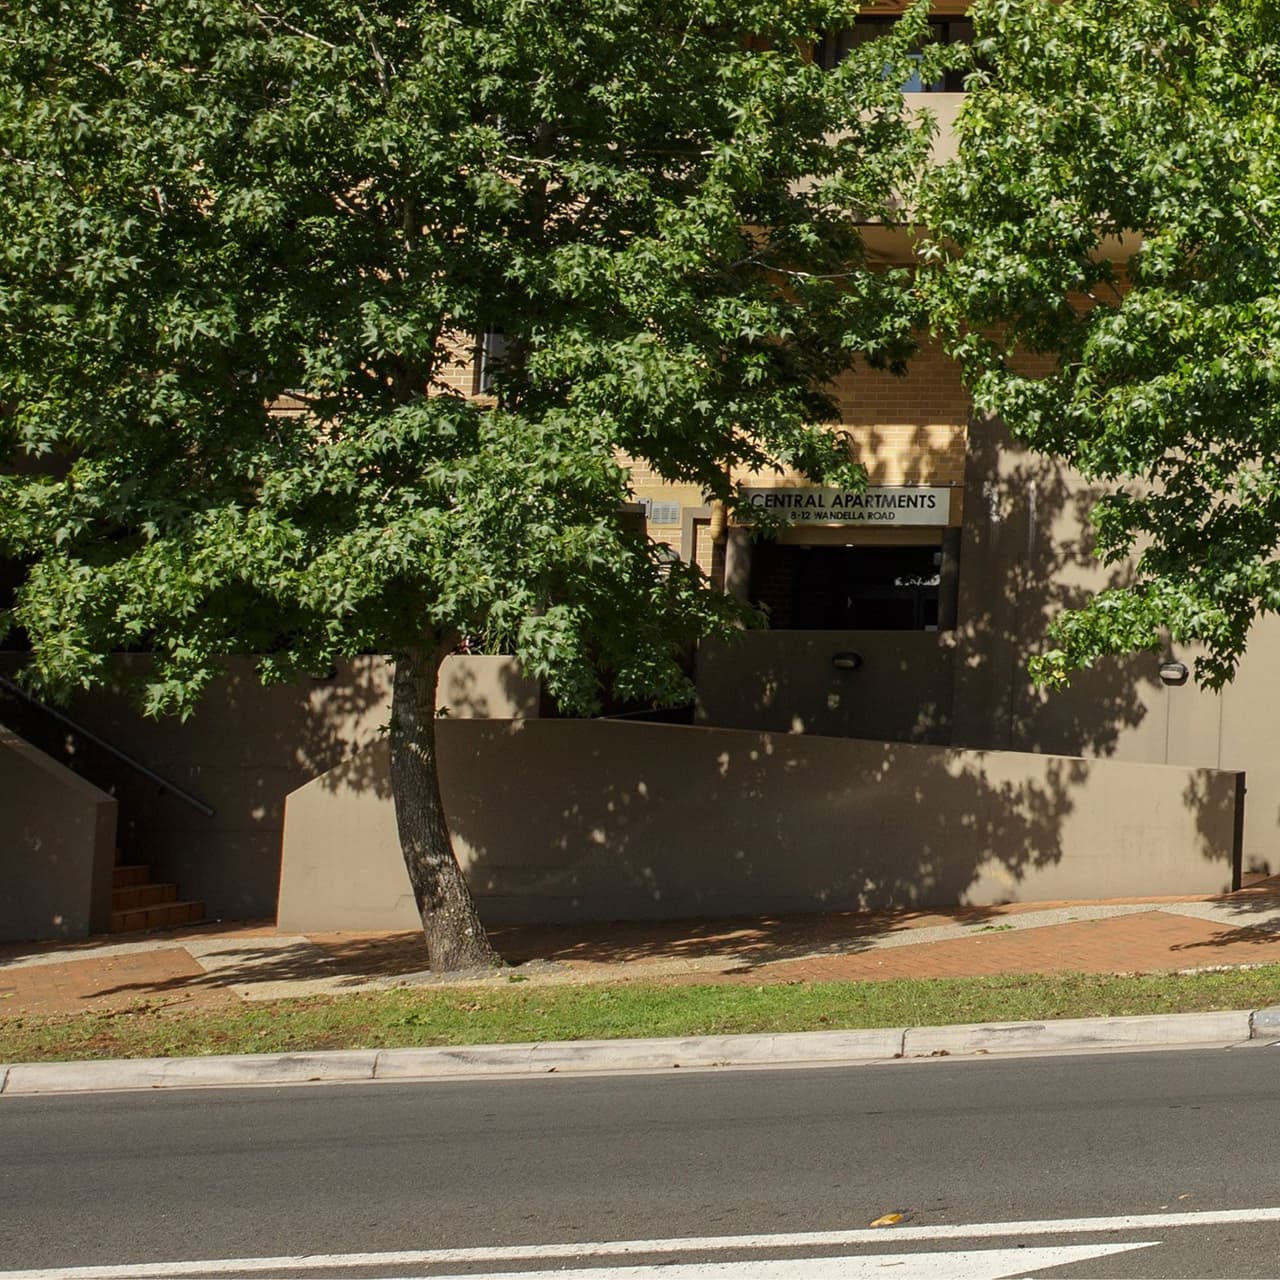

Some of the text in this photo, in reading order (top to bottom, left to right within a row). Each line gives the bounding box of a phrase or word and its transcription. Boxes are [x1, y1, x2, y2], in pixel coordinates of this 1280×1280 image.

[751, 494, 936, 508] CENTRAL APARTMENTS
[790, 511, 896, 520] 8-12 WANDELLA ROAD
